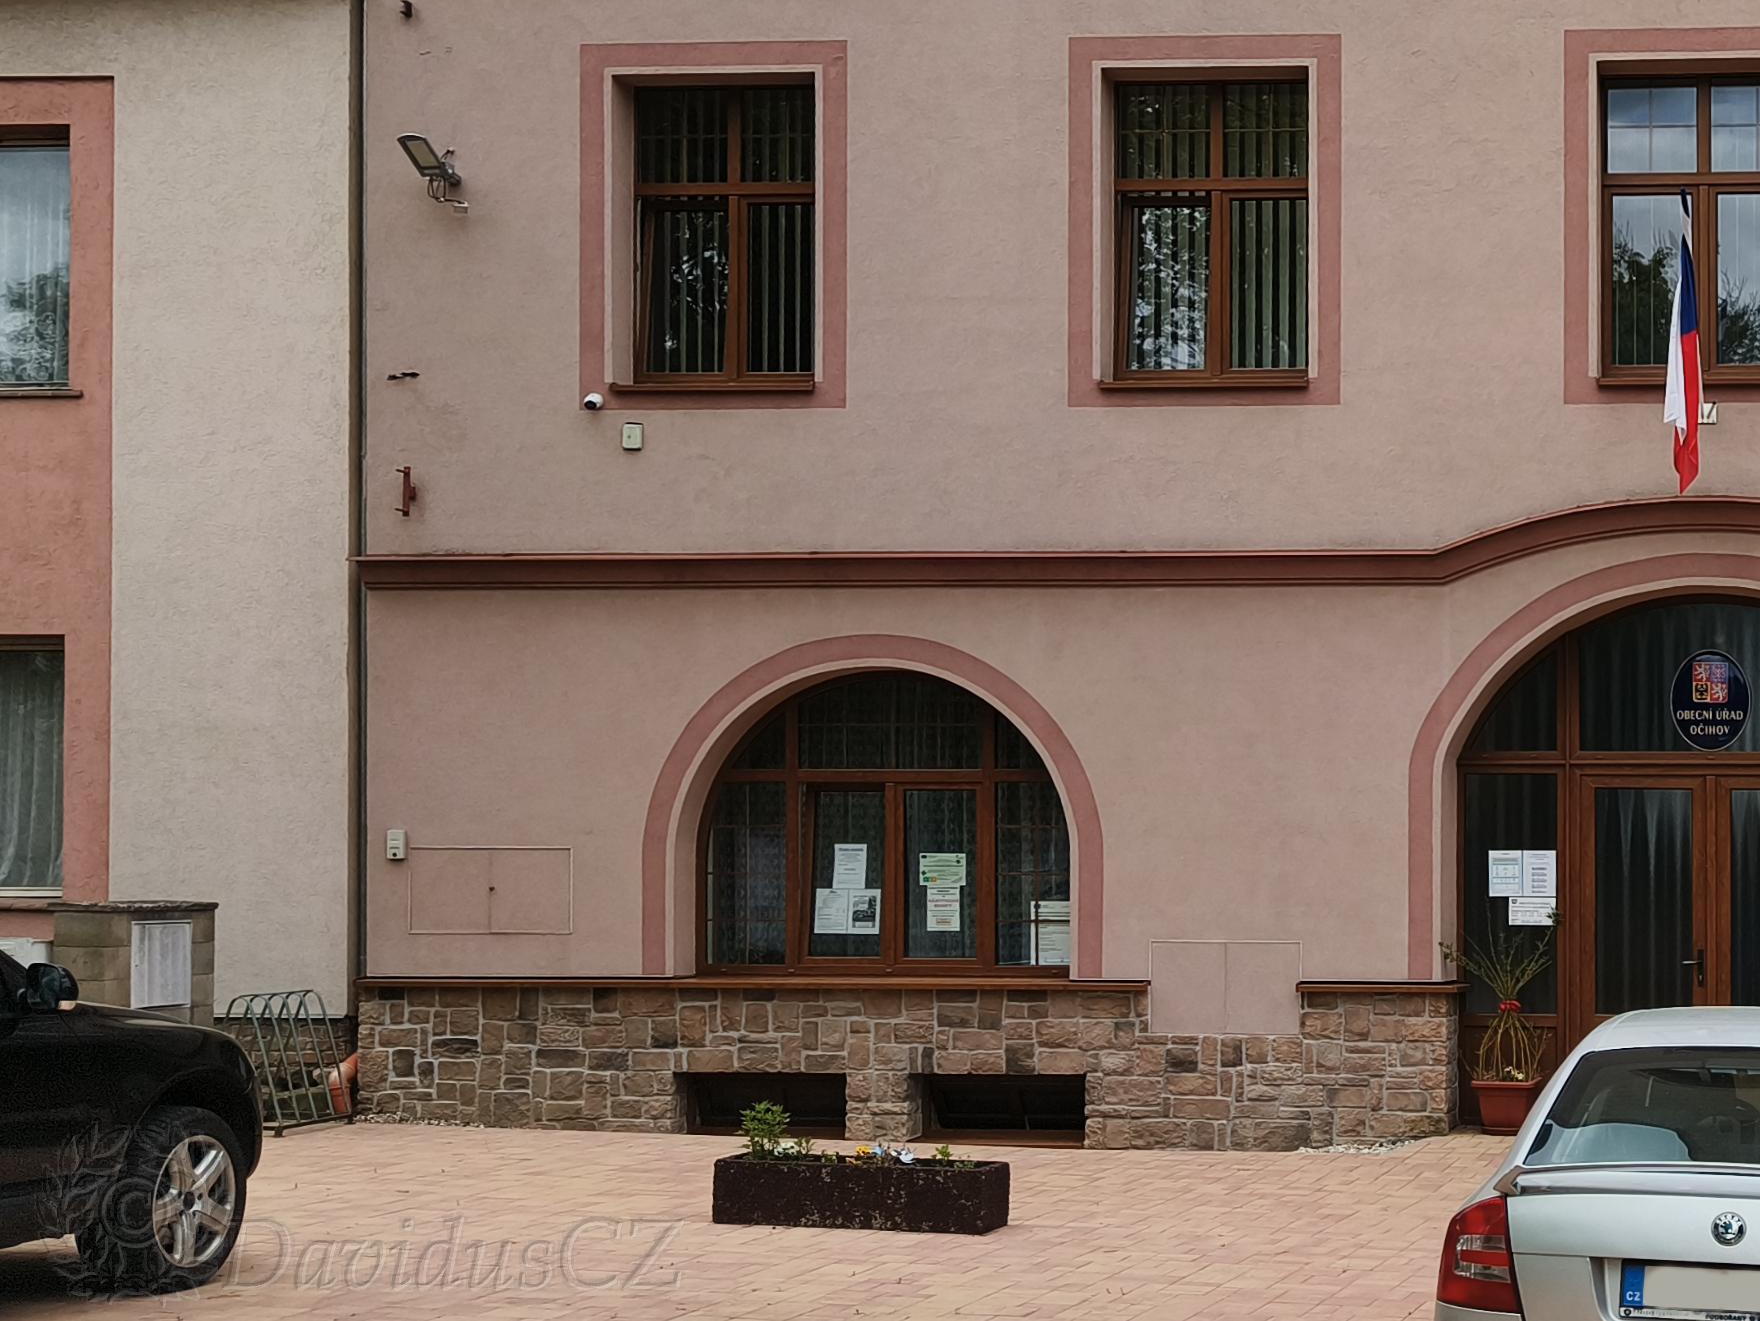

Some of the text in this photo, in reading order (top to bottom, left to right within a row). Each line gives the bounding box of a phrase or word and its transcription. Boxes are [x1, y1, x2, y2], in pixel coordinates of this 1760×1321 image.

[1676, 708, 1744, 721] OBECNÍ ÚŘAD
[1690, 723, 1730, 735] OČIHOV
[1625, 1290, 1641, 1302] CZ
